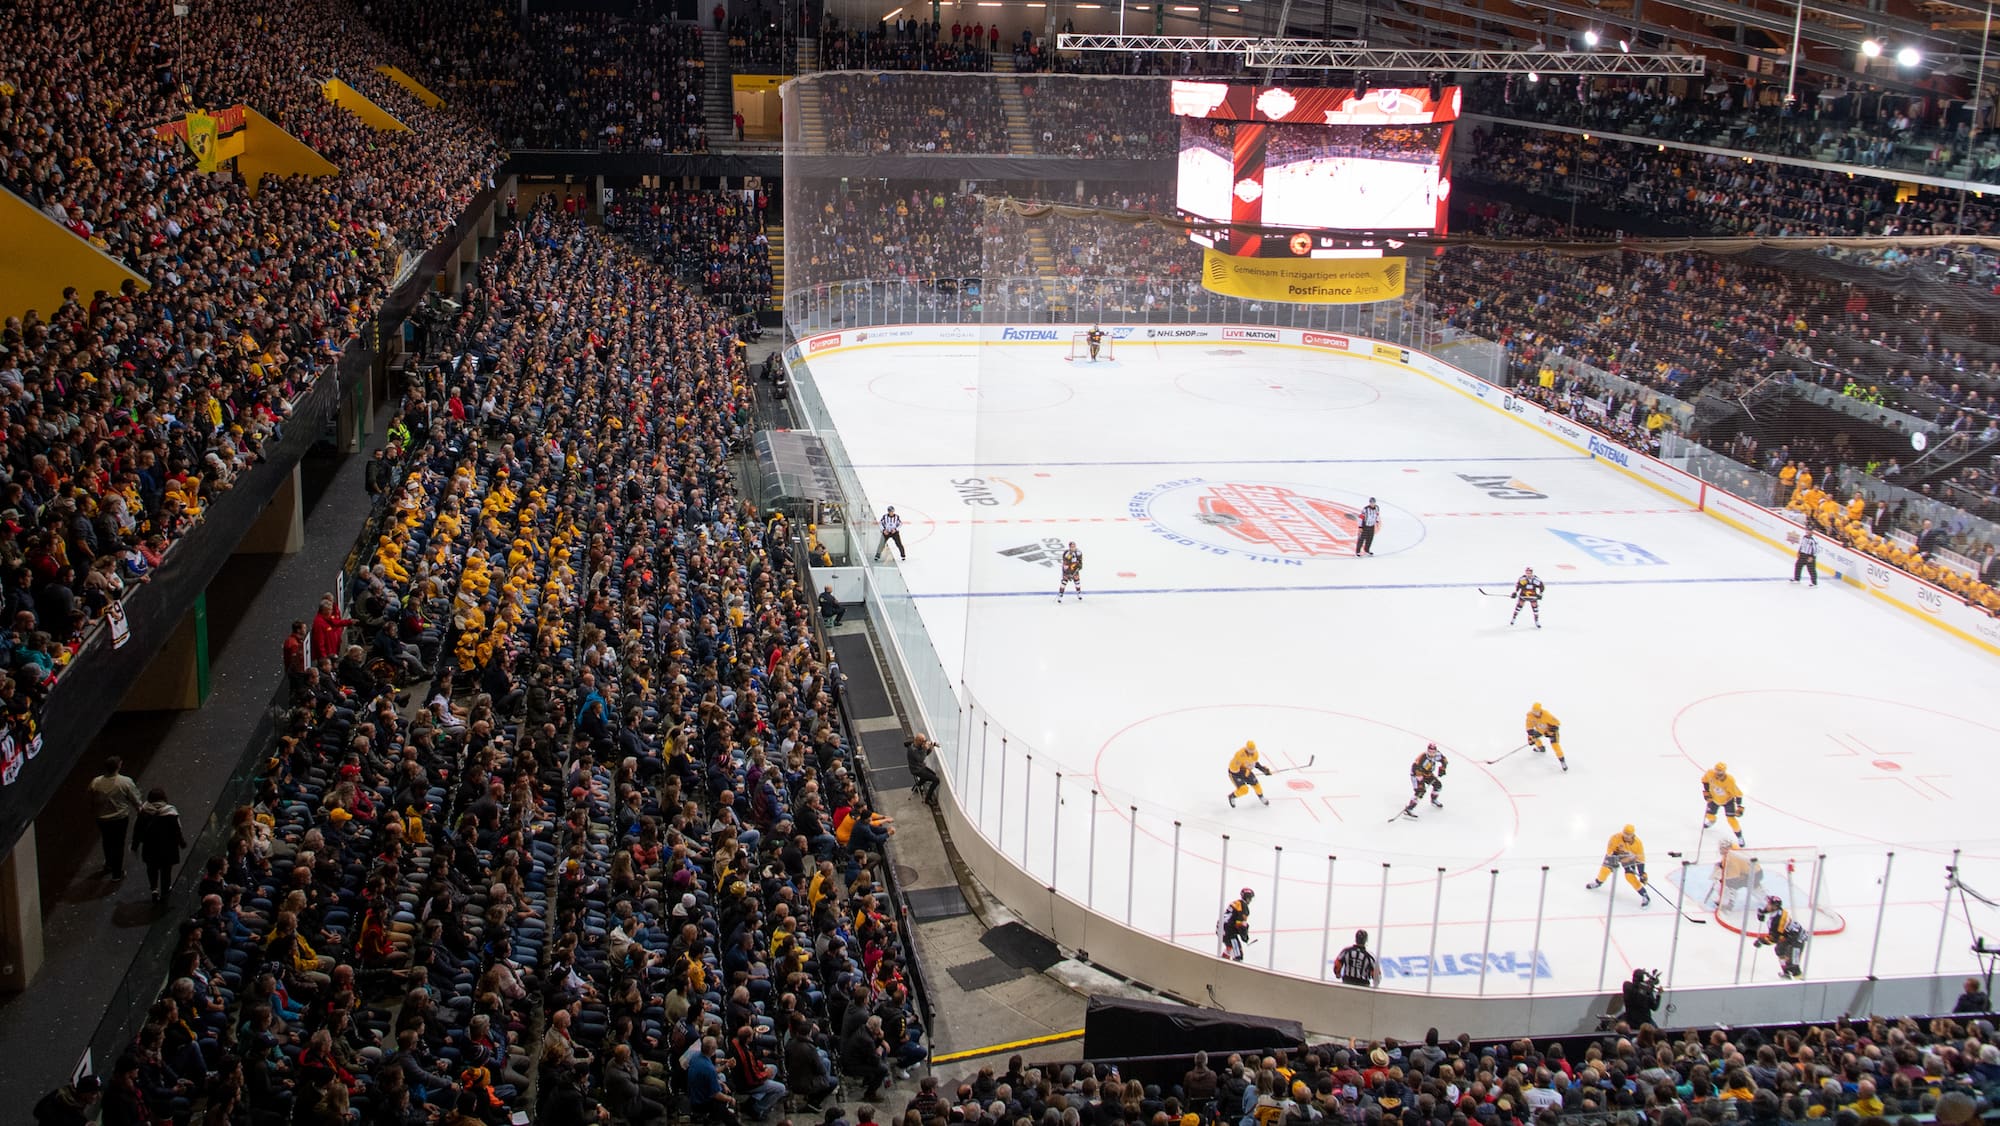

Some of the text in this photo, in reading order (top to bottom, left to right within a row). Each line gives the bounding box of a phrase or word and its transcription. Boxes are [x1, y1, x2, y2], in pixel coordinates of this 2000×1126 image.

[604, 190, 612, 199] K
[1233, 264, 1373, 281] Gemeinsam Einzigartiges erleben.
[1288, 285, 1379, 296] PostFinance Arena
[1002, 327, 1059, 340] FASTENAL
[1245, 331, 1276, 339] NATION
[1587, 434, 1629, 467] FASTENAL
[1455, 473, 1549, 499] CAT
[1144, 522, 1229, 556] GLOBAL
[1245, 553, 1303, 566] NHL
[1866, 563, 1890, 583] aws
[1918, 587, 1942, 607] aws
[1328, 950, 1553, 979] FASTEN
